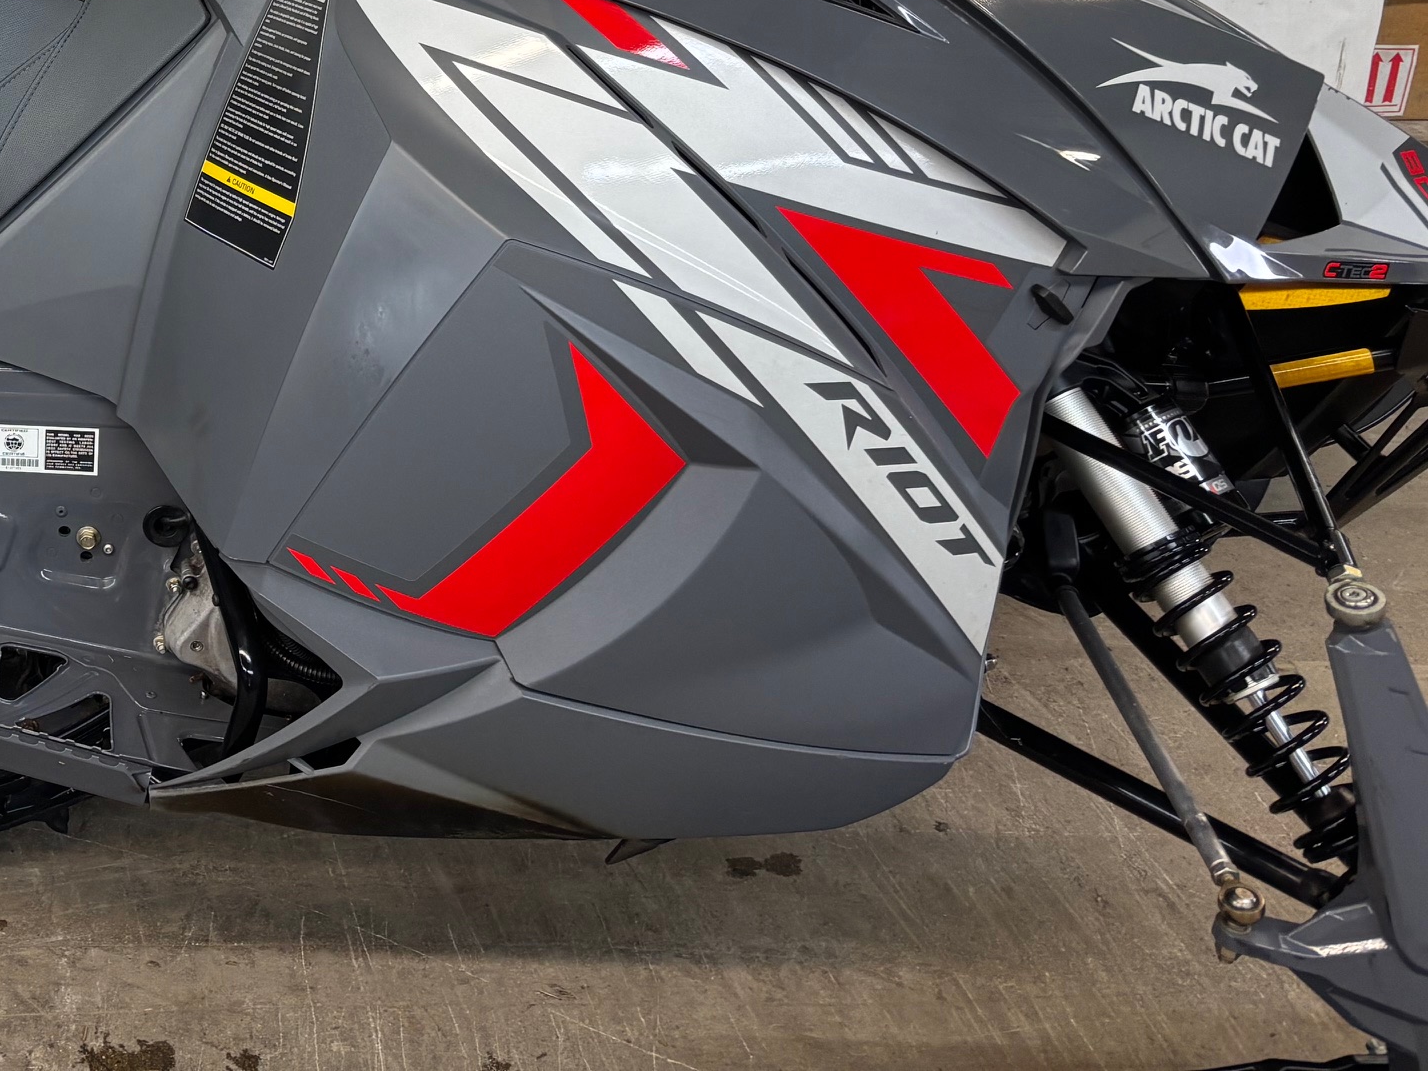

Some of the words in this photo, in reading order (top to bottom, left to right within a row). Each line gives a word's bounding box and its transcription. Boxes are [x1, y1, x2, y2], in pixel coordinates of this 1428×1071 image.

[1131, 83, 1229, 148] ARCTIC
[1232, 122, 1281, 168] CAT
[232, 178, 255, 195] CAUTION
[803, 381, 997, 568] RIOT
